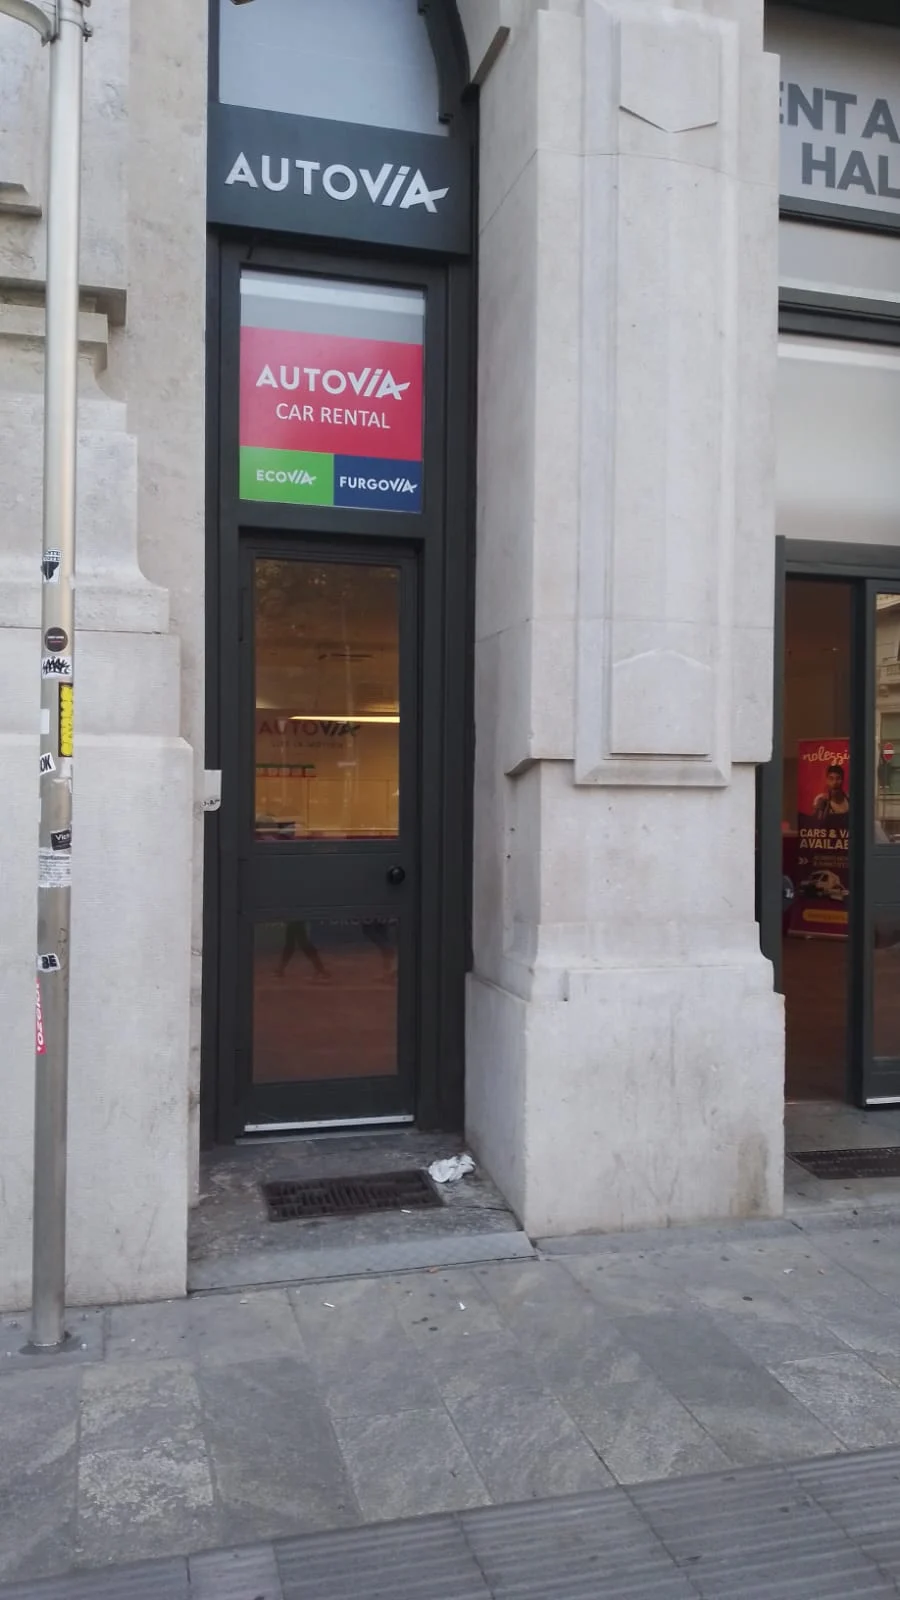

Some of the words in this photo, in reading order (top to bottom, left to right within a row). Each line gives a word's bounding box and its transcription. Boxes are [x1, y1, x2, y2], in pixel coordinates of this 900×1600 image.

[275, 402, 314, 422] CAR
[320, 406, 391, 429] RENTAL
[799, 828, 827, 838] CARS
[829, 829, 837, 838] &
